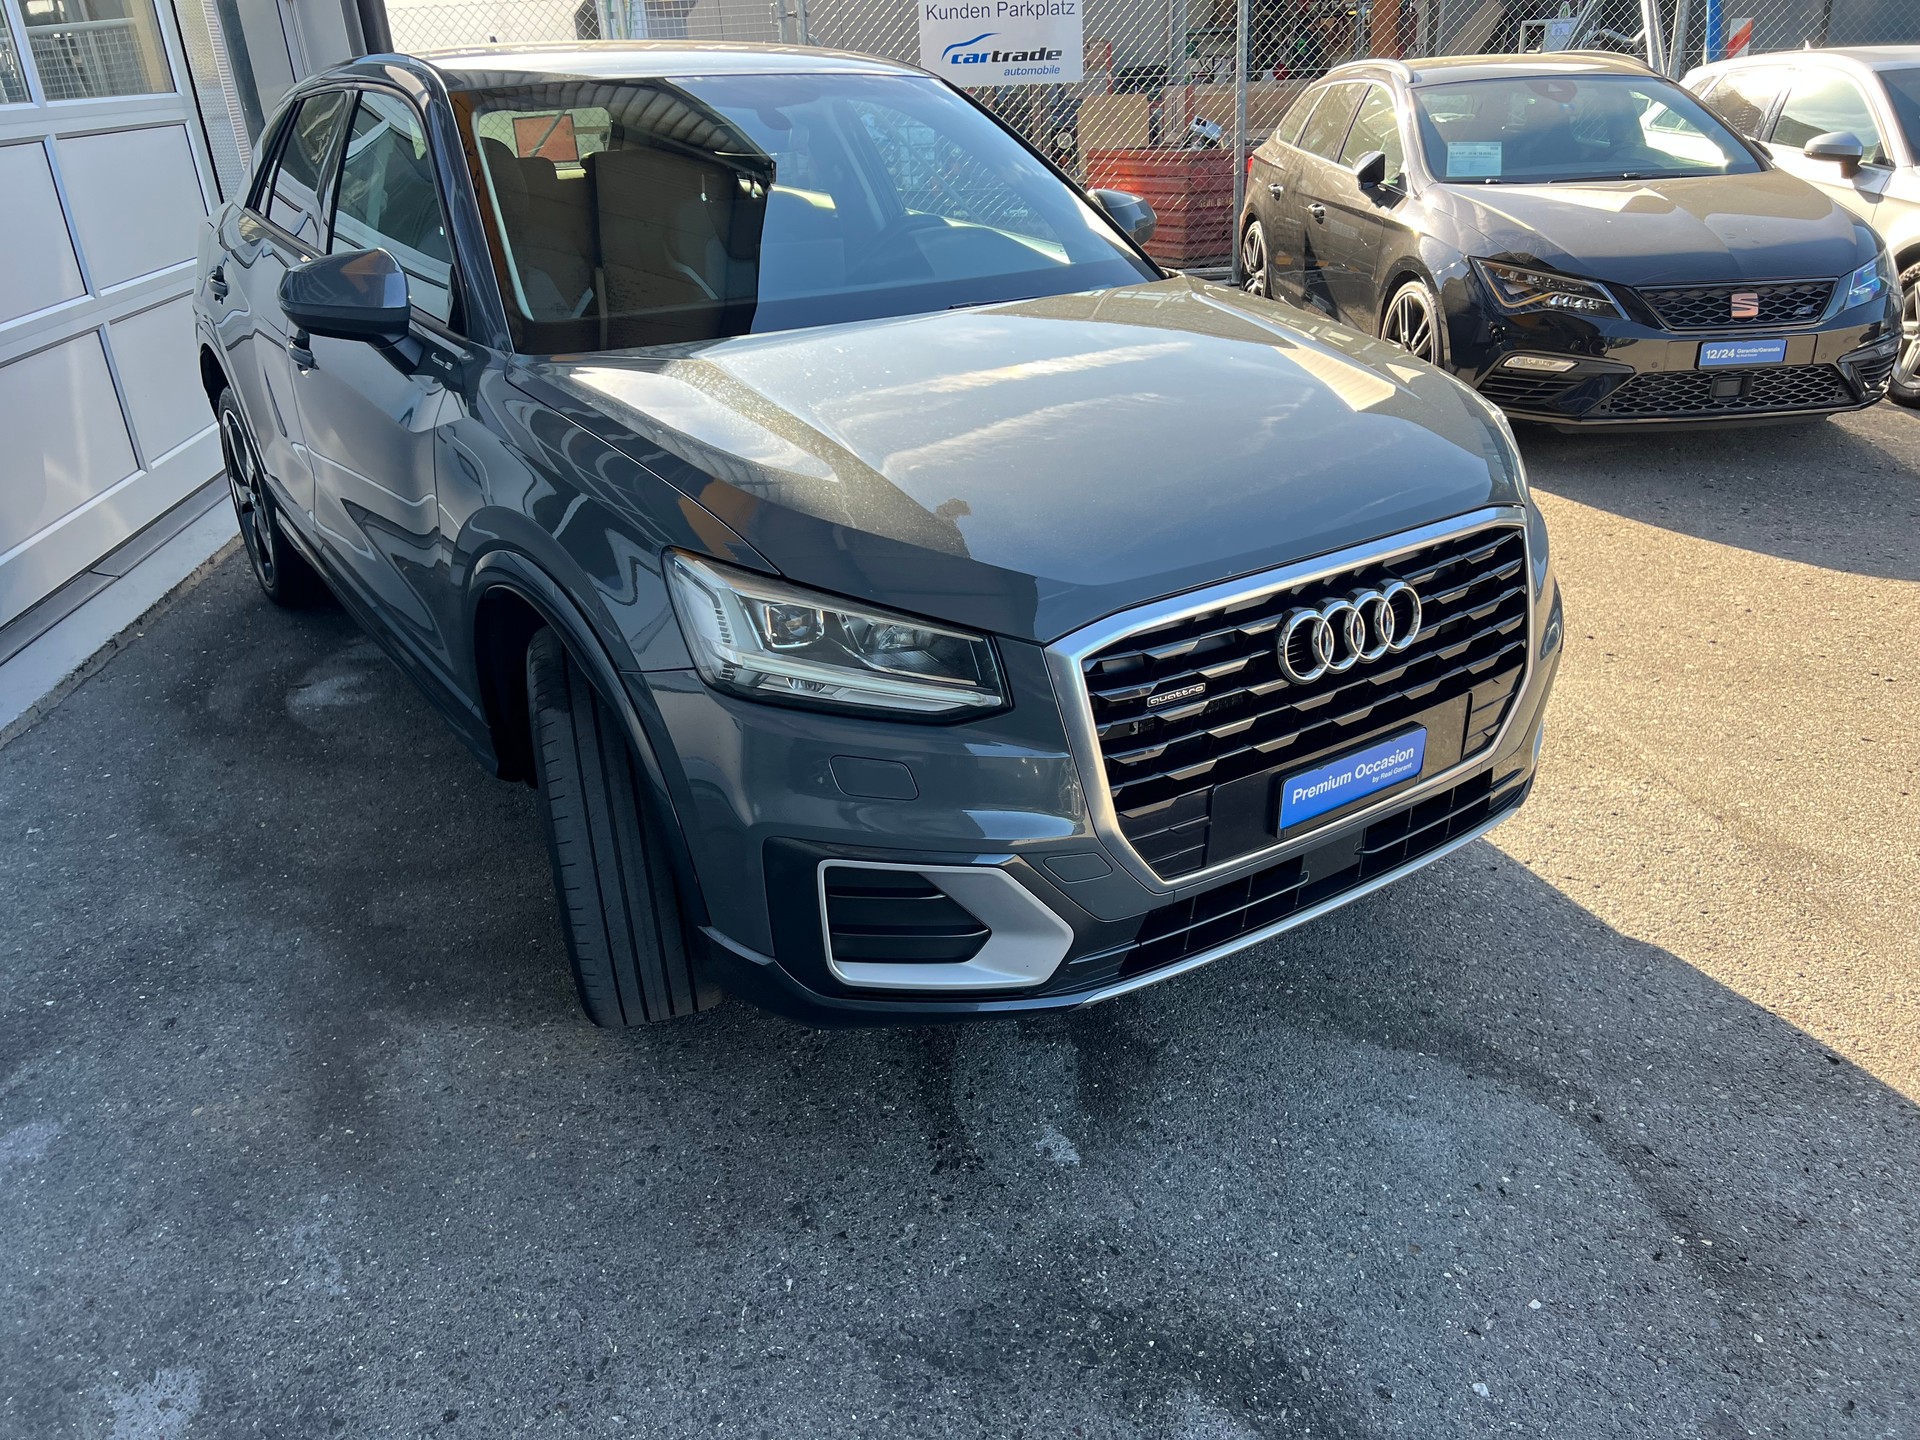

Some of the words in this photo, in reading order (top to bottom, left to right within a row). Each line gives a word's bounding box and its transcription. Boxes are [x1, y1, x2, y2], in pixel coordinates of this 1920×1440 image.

[926, 3, 990, 20] Kunden
[997, 1, 1075, 22] Parkplatz
[951, 47, 1062, 65] cartrade
[1004, 65, 1060, 76] automobile
[1706, 348, 1735, 359] 12/24
[1150, 685, 1204, 704] quattro
[1292, 772, 1352, 804] Premium
[1355, 747, 1414, 779] Occasion
